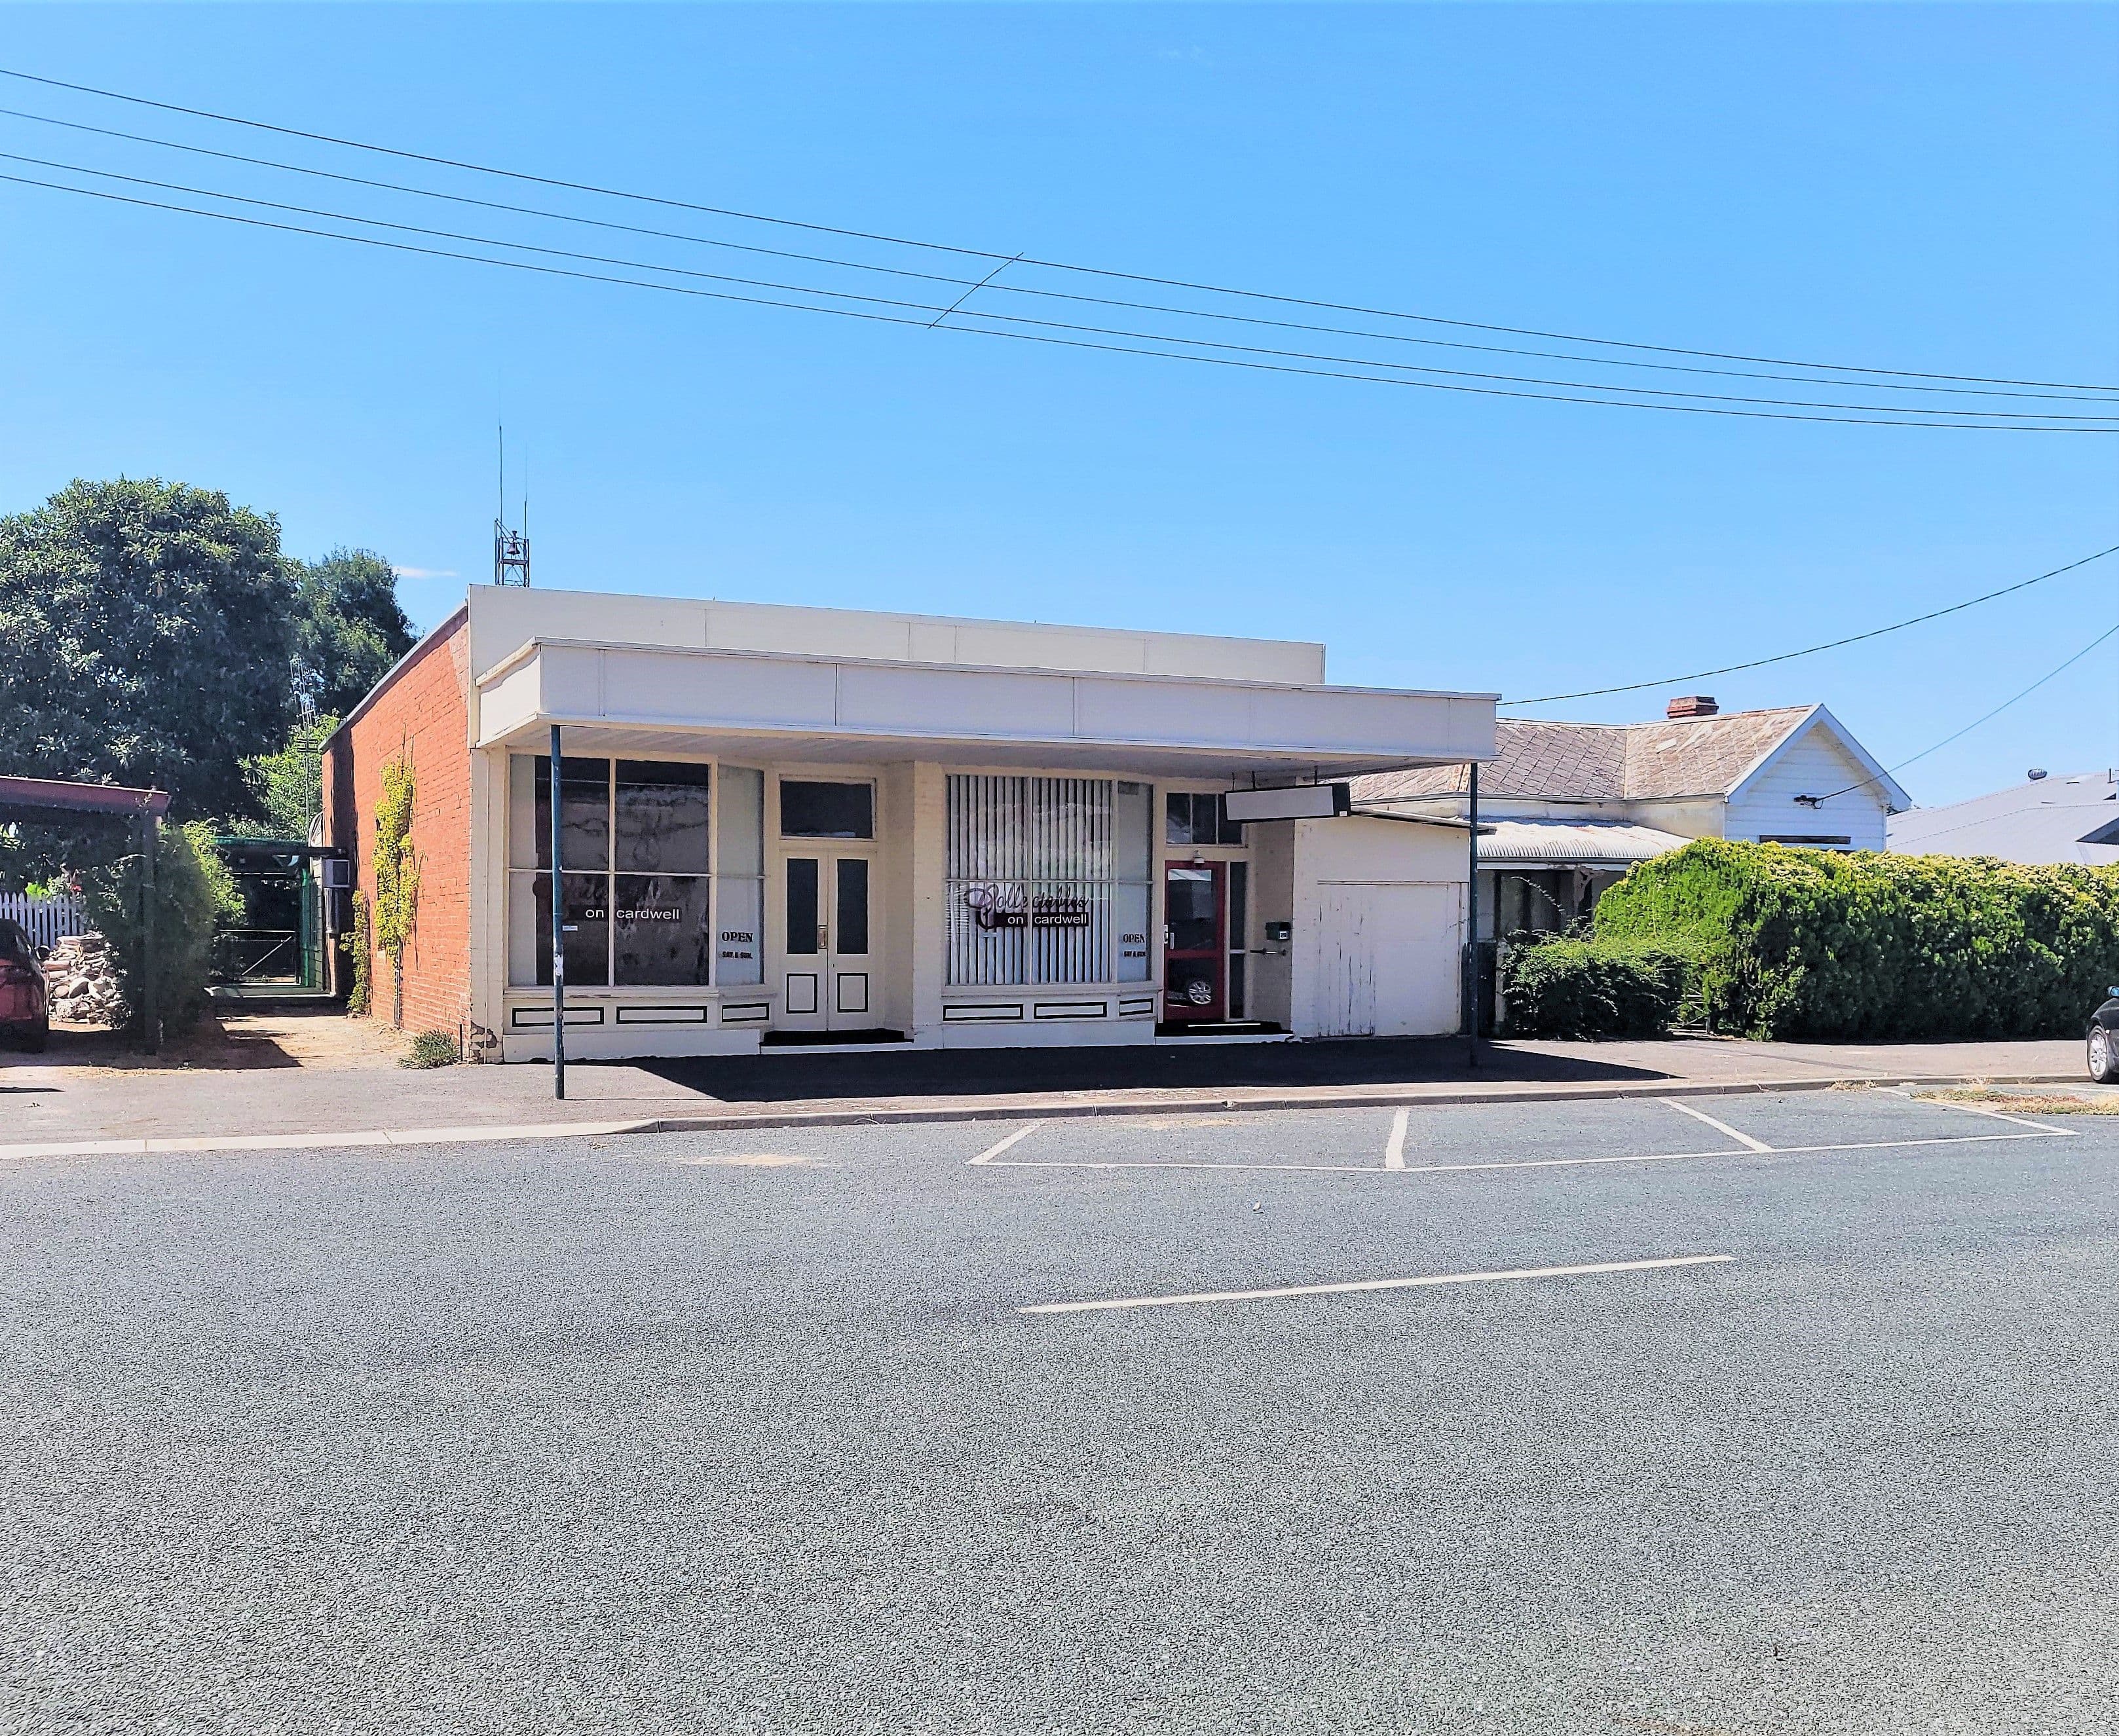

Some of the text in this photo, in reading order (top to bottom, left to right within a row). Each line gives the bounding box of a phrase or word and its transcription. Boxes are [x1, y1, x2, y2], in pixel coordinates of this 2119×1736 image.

[585, 908, 679, 919] on cardwell
[1007, 914, 1087, 925] on cardwell
[721, 931, 753, 942] OPEN
[1123, 933, 1145, 943] OPEN
